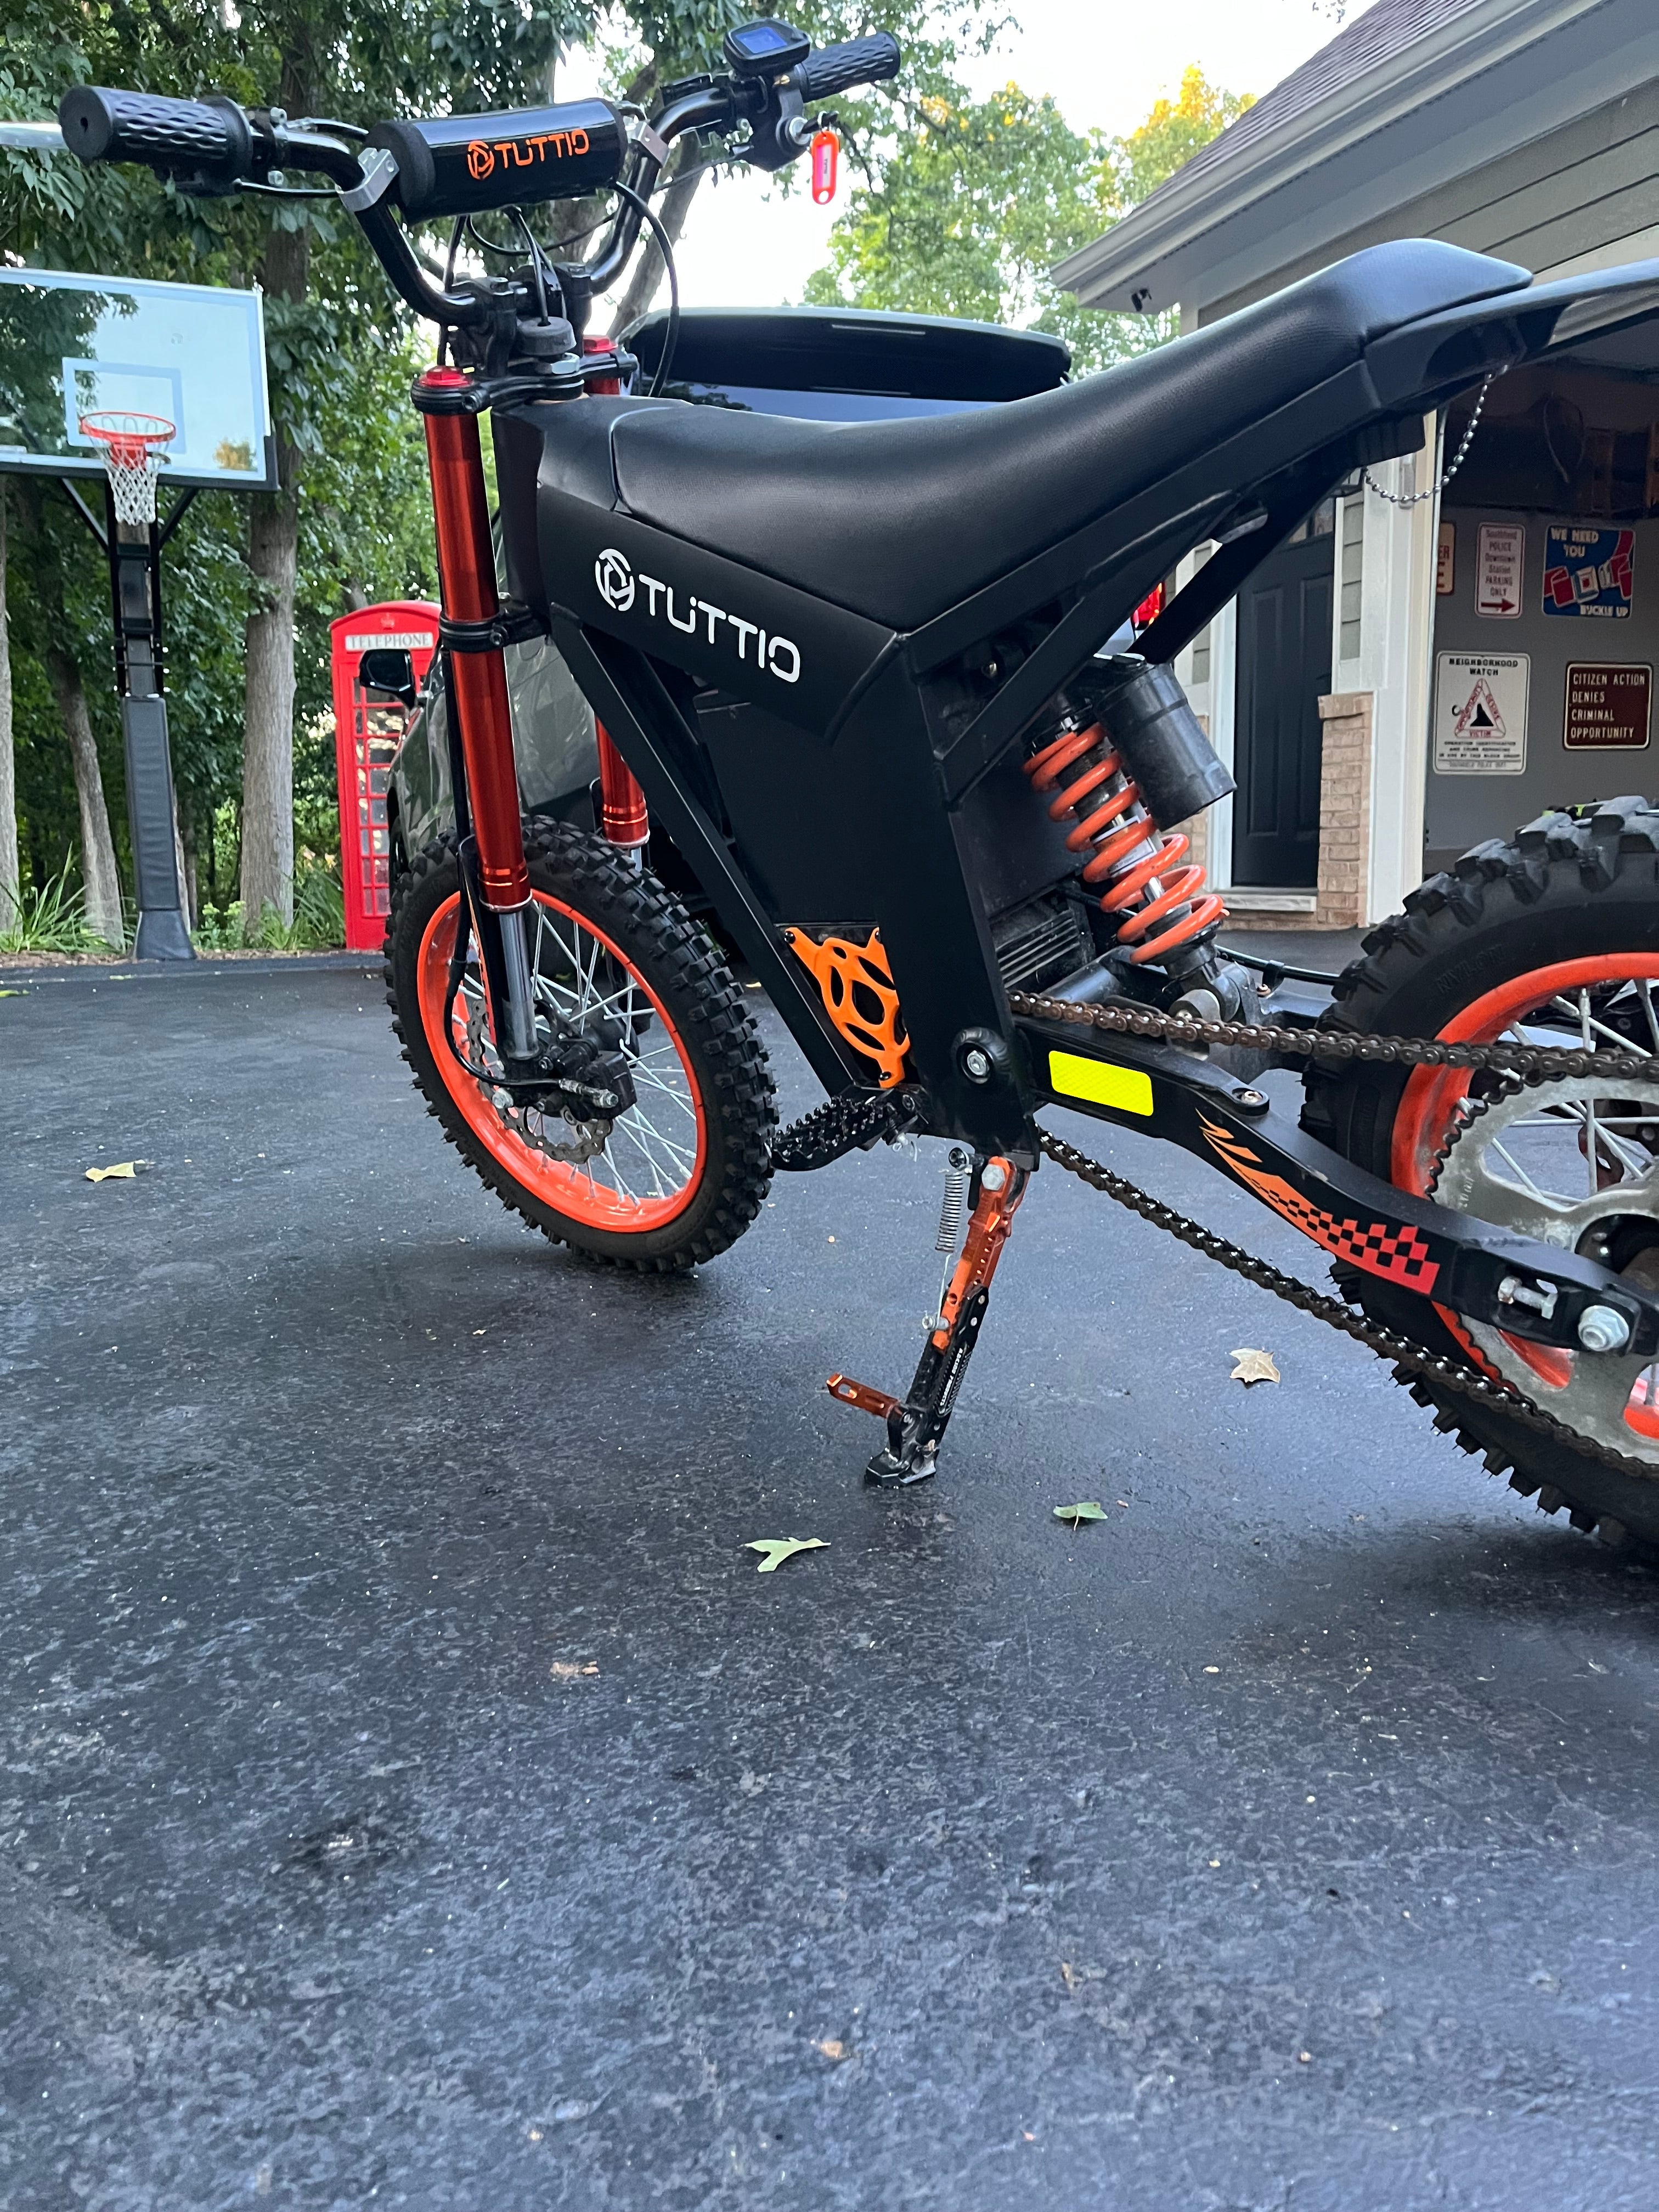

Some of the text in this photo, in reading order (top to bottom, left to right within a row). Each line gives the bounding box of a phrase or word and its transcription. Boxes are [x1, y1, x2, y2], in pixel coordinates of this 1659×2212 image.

[495, 128, 590, 168] TUTTIO
[1551, 527, 1599, 544] WE NEED
[1489, 541, 1511, 552] POLICE
[1564, 544, 1585, 557] YOU
[1485, 575, 1513, 586] PARKING
[1490, 587, 1506, 597] ONLY
[1580, 605, 1628, 617] BUCKLE UP
[639, 574, 800, 682] TUTTIO
[351, 634, 429, 648] TELEPHONE
[1449, 658, 1519, 668] NEIGHBORHOOD
[1470, 668, 1499, 676] WATCH
[1573, 673, 1645, 686] CITIZEN ACTION
[1572, 691, 1605, 703] DENIES
[1571, 709, 1615, 721] CRIMINAL
[1571, 726, 1634, 739] OPPORTUNITY
